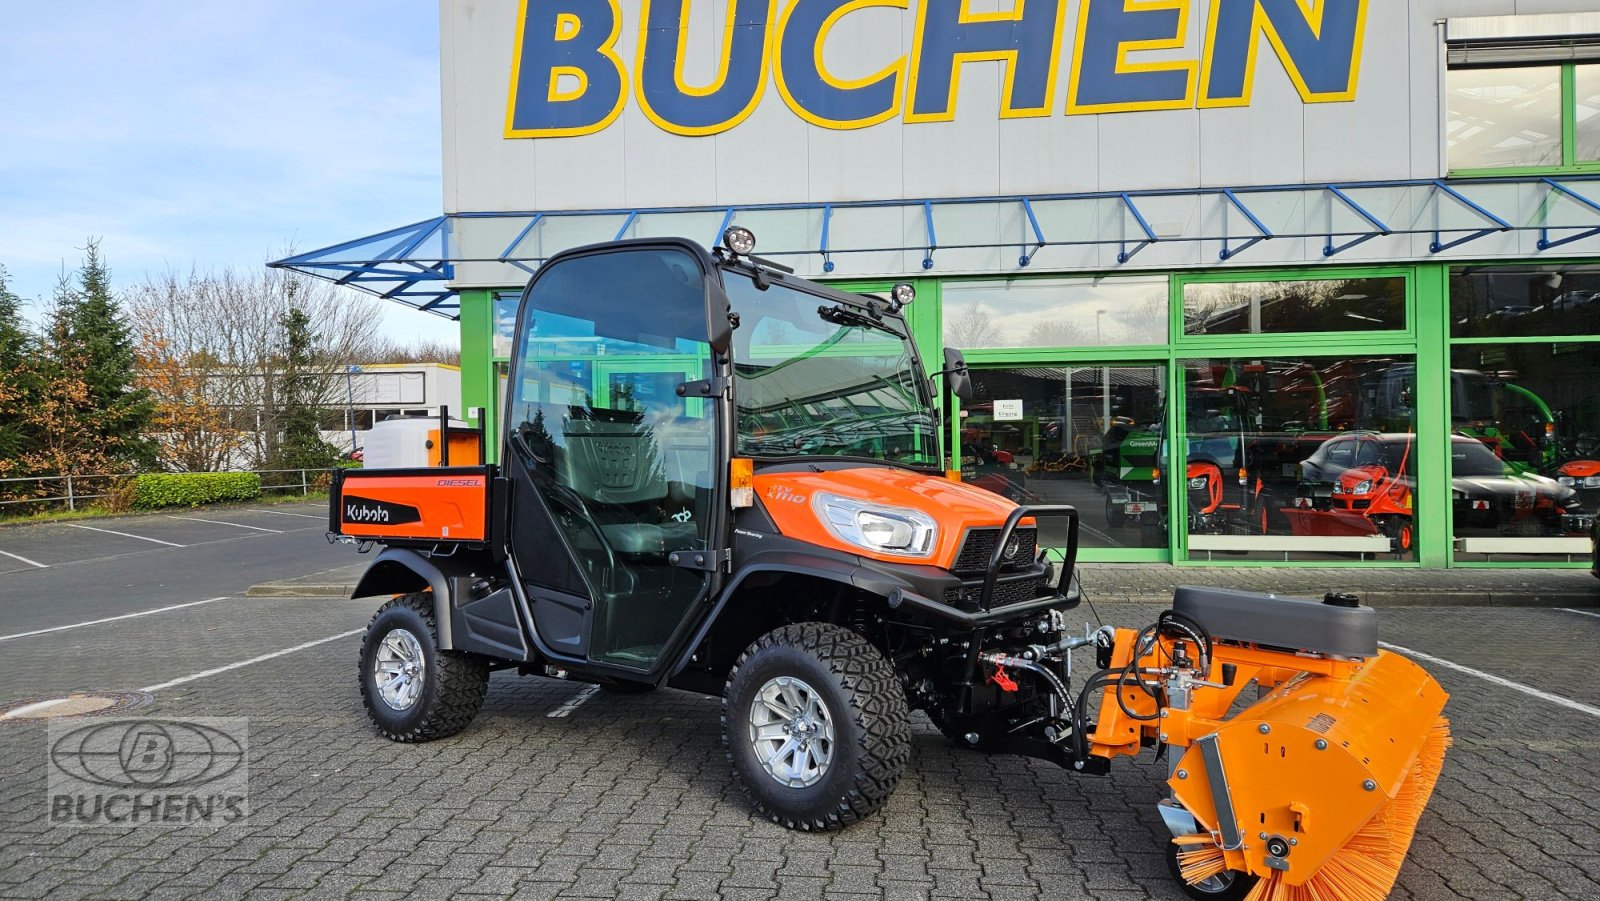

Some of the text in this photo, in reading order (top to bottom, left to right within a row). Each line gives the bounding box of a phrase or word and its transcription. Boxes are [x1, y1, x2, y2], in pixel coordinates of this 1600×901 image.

[503, 0, 1370, 140] BUCHEN
[437, 479, 483, 487] DIESEL
[346, 504, 389, 522] Kubota
